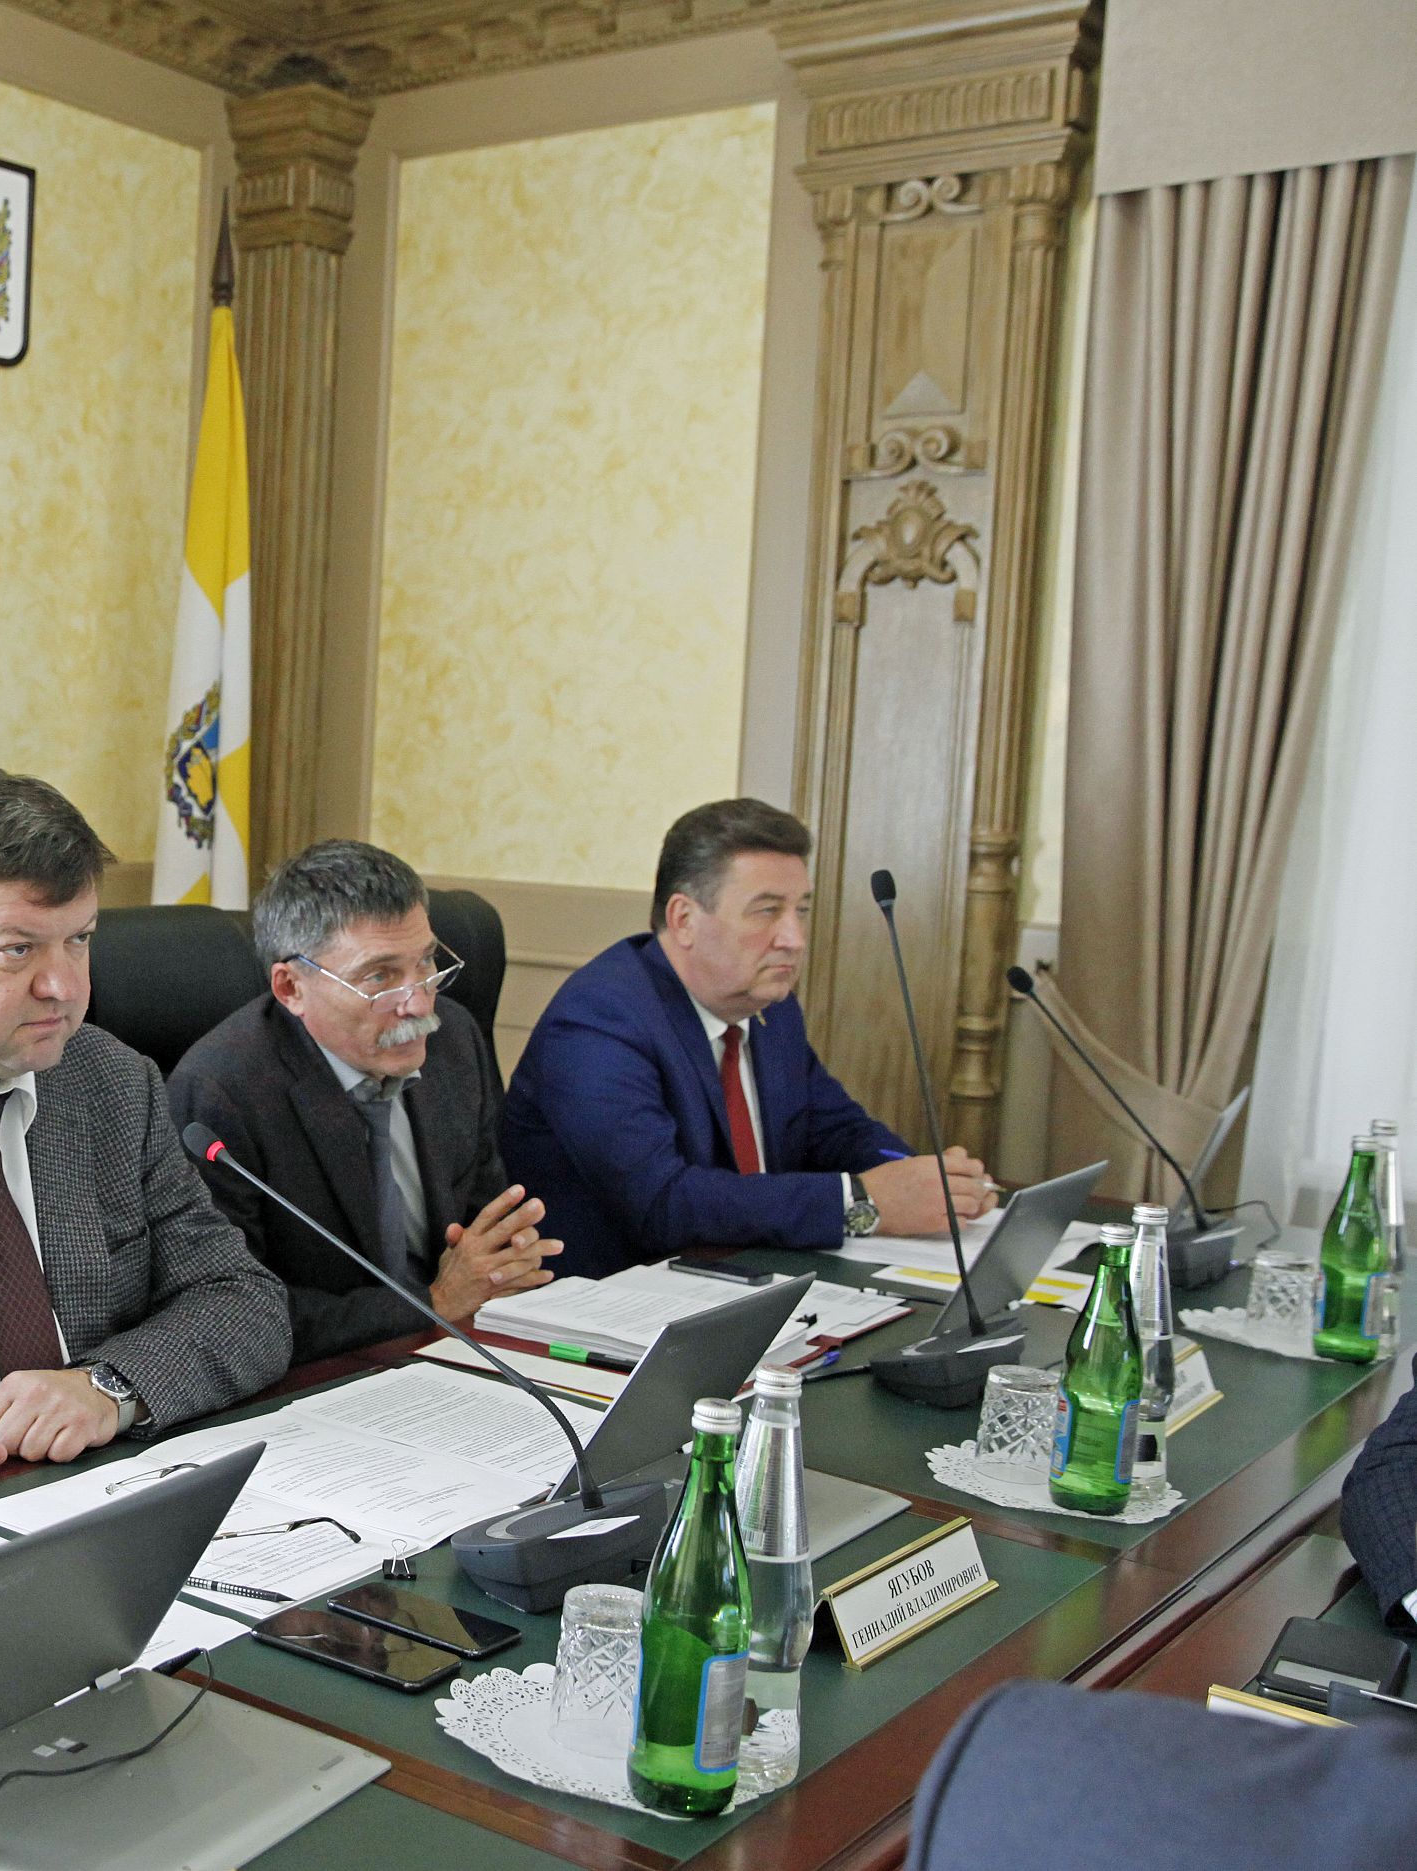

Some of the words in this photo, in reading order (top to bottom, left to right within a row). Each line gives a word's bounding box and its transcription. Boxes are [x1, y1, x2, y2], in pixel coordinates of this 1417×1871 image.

[852, 1603, 907, 1649] ГЕННАДИЙ
[907, 1563, 982, 1617] ВЛАДИМИРОВИЧ
[888, 1559, 935, 1599] ЯГУБОВ
